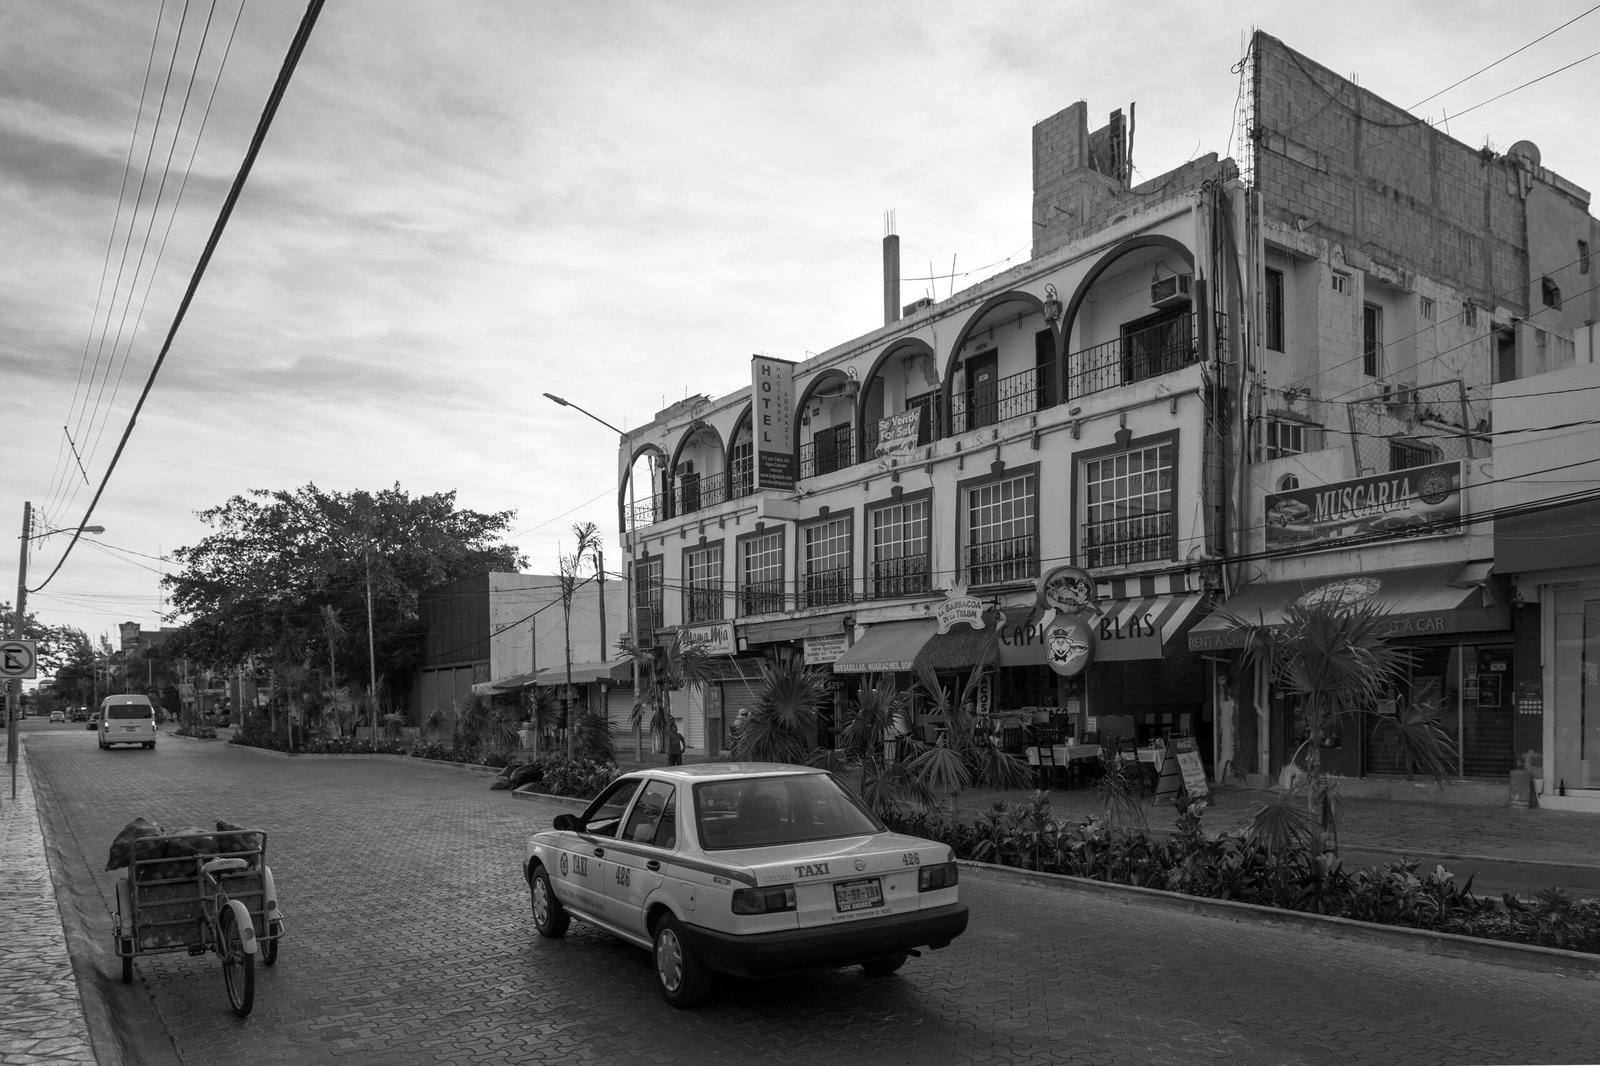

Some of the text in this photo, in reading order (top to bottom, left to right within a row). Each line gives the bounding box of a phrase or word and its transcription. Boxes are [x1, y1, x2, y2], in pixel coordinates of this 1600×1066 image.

[761, 364, 772, 443] HOTEL
[878, 420, 890, 431] Se
[880, 431, 895, 442] For
[1313, 477, 1410, 523] MUSCARIA
[1354, 520, 1376, 534] A
[1384, 511, 1447, 530] CAR
[945, 600, 982, 612] BARBACOA
[956, 609, 977, 619] TULUM
[1001, 613, 1155, 646] CAPI BLAS
[1404, 618, 1414, 631] A
[1416, 617, 1444, 631] CAR
[710, 626, 729, 645] Mia
[1189, 635, 1213, 648] RENT
[1215, 634, 1223, 646] A
[834, 663, 867, 673] QUESADILLAS,
[868, 661, 900, 672] HUARACHES,
[980, 675, 988, 712] ACOS
[573, 854, 588, 877] TAXI
[902, 852, 920, 866] 426
[615, 866, 631, 888] 426
[794, 862, 831, 878] TAXI
